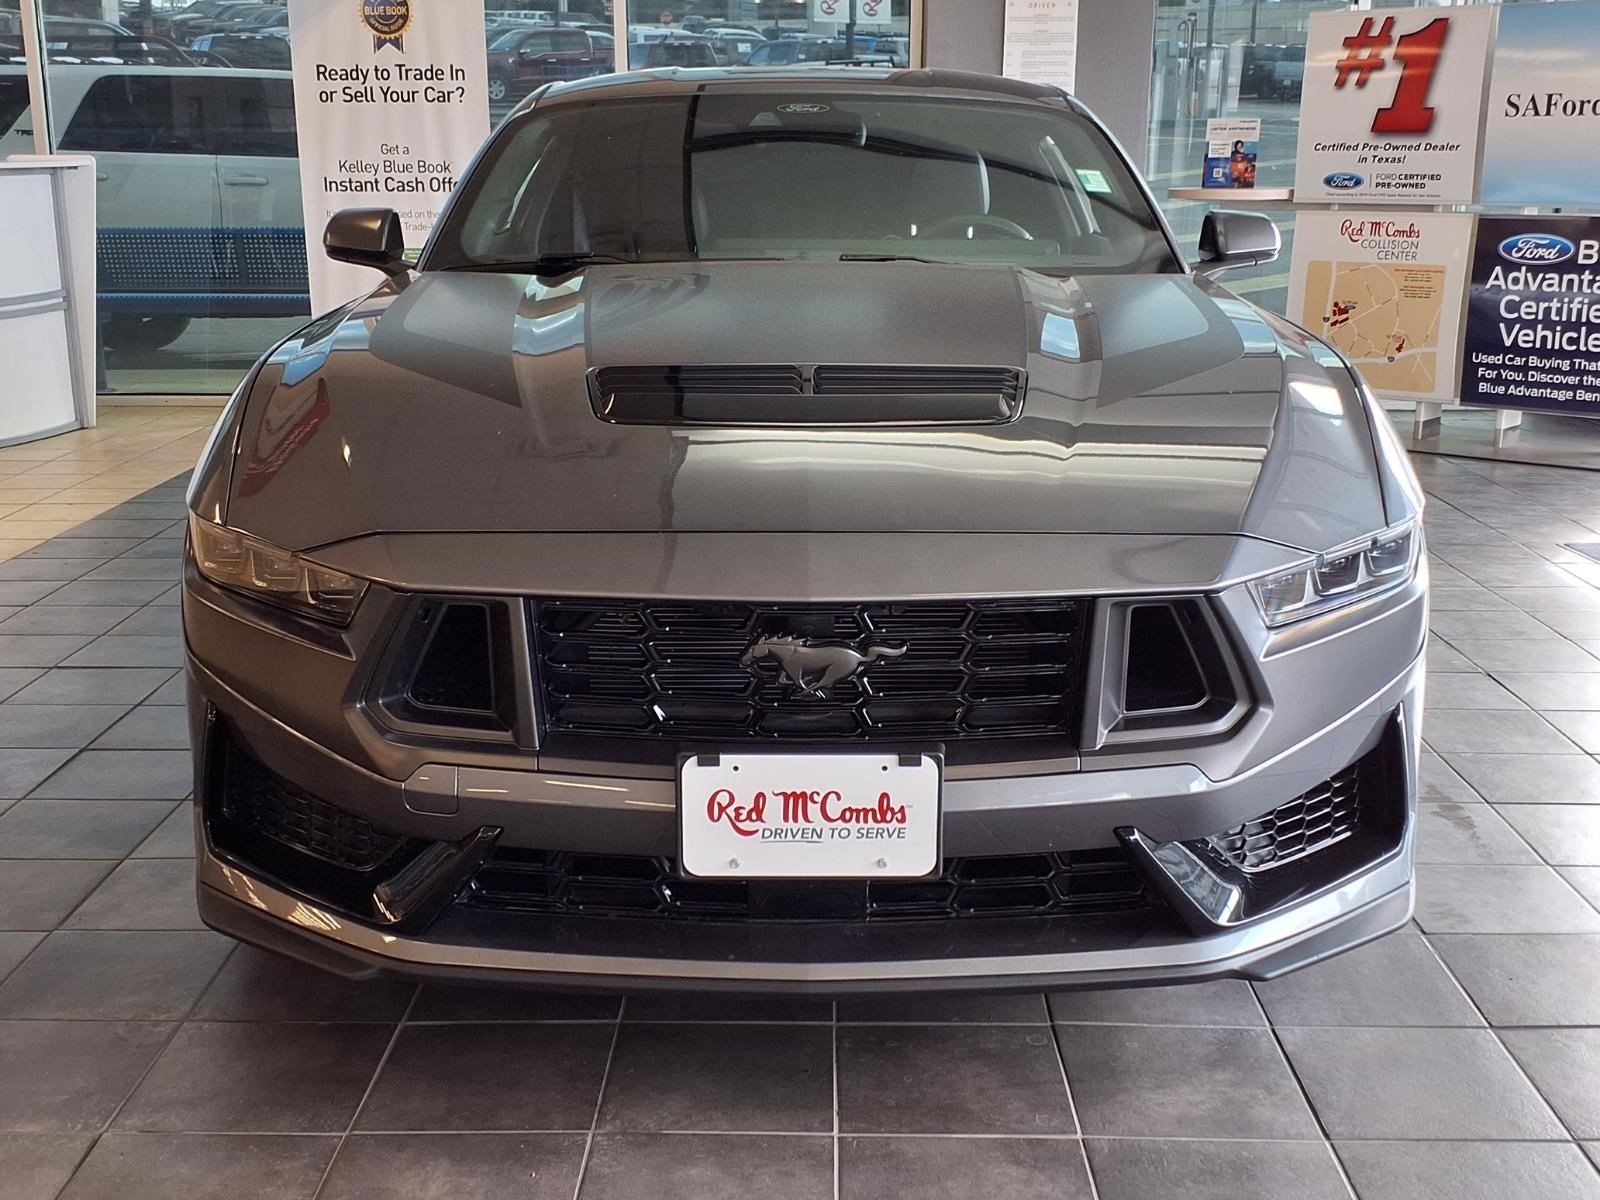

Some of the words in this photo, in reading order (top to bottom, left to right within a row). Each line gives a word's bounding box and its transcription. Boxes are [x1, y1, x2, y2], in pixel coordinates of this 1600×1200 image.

[364, 6, 385, 15] BLUE
[385, 6, 408, 15] BOOK
[316, 64, 370, 84] Ready
[374, 65, 390, 81] to
[395, 64, 445, 81] Trade
[449, 64, 466, 81] In
[1334, 16, 1450, 133] #1
[319, 90, 337, 103] or
[342, 86, 376, 103] Sell
[379, 86, 419, 103] Your
[424, 86, 465, 103] Car?
[786, 103, 820, 113] Ford
[380, 143, 400, 155] Get
[402, 146, 409, 155] a
[1313, 142, 1359, 152] Certified
[1361, 142, 1421, 152] Pre-Owned
[1424, 142, 1461, 152] Dealer
[1357, 155, 1368, 164] in
[1371, 155, 1406, 164] Texas!
[338, 160, 379, 176] Kelley
[383, 160, 413, 173] Blue
[417, 160, 451, 173] Book
[1330, 174, 1357, 188] Ford
[1375, 173, 1397, 181] FORD
[1398, 173, 1442, 181] CERTIFIED
[323, 177, 380, 192] Instant
[384, 177, 425, 193] Cash
[1375, 181, 1427, 190] PRE-OWNED
[414, 211, 425, 219] on
[1340, 219, 1366, 243] Red
[1367, 220, 1420, 239] McCombs
[1360, 239, 1419, 250] COLLISION
[1511, 237, 1562, 260] Ford
[1376, 250, 1418, 261] CENTER
[1472, 352, 1503, 364] Used
[1504, 354, 1526, 366] Car
[1528, 356, 1571, 371] Buying
[1573, 358, 1600, 371] That
[1477, 367, 1497, 379] For
[1500, 369, 1526, 380] You.
[1528, 371, 1581, 385] Discover
[1582, 375, 1600, 387] the
[1478, 382, 1505, 395] Blue
[1507, 384, 1574, 400] Advantage
[706, 788, 767, 837] Red
[771, 790, 907, 825] McCombs
[761, 827, 823, 840] DRIVEN
[828, 827, 851, 839] TO
[856, 827, 907, 839] SERVE
